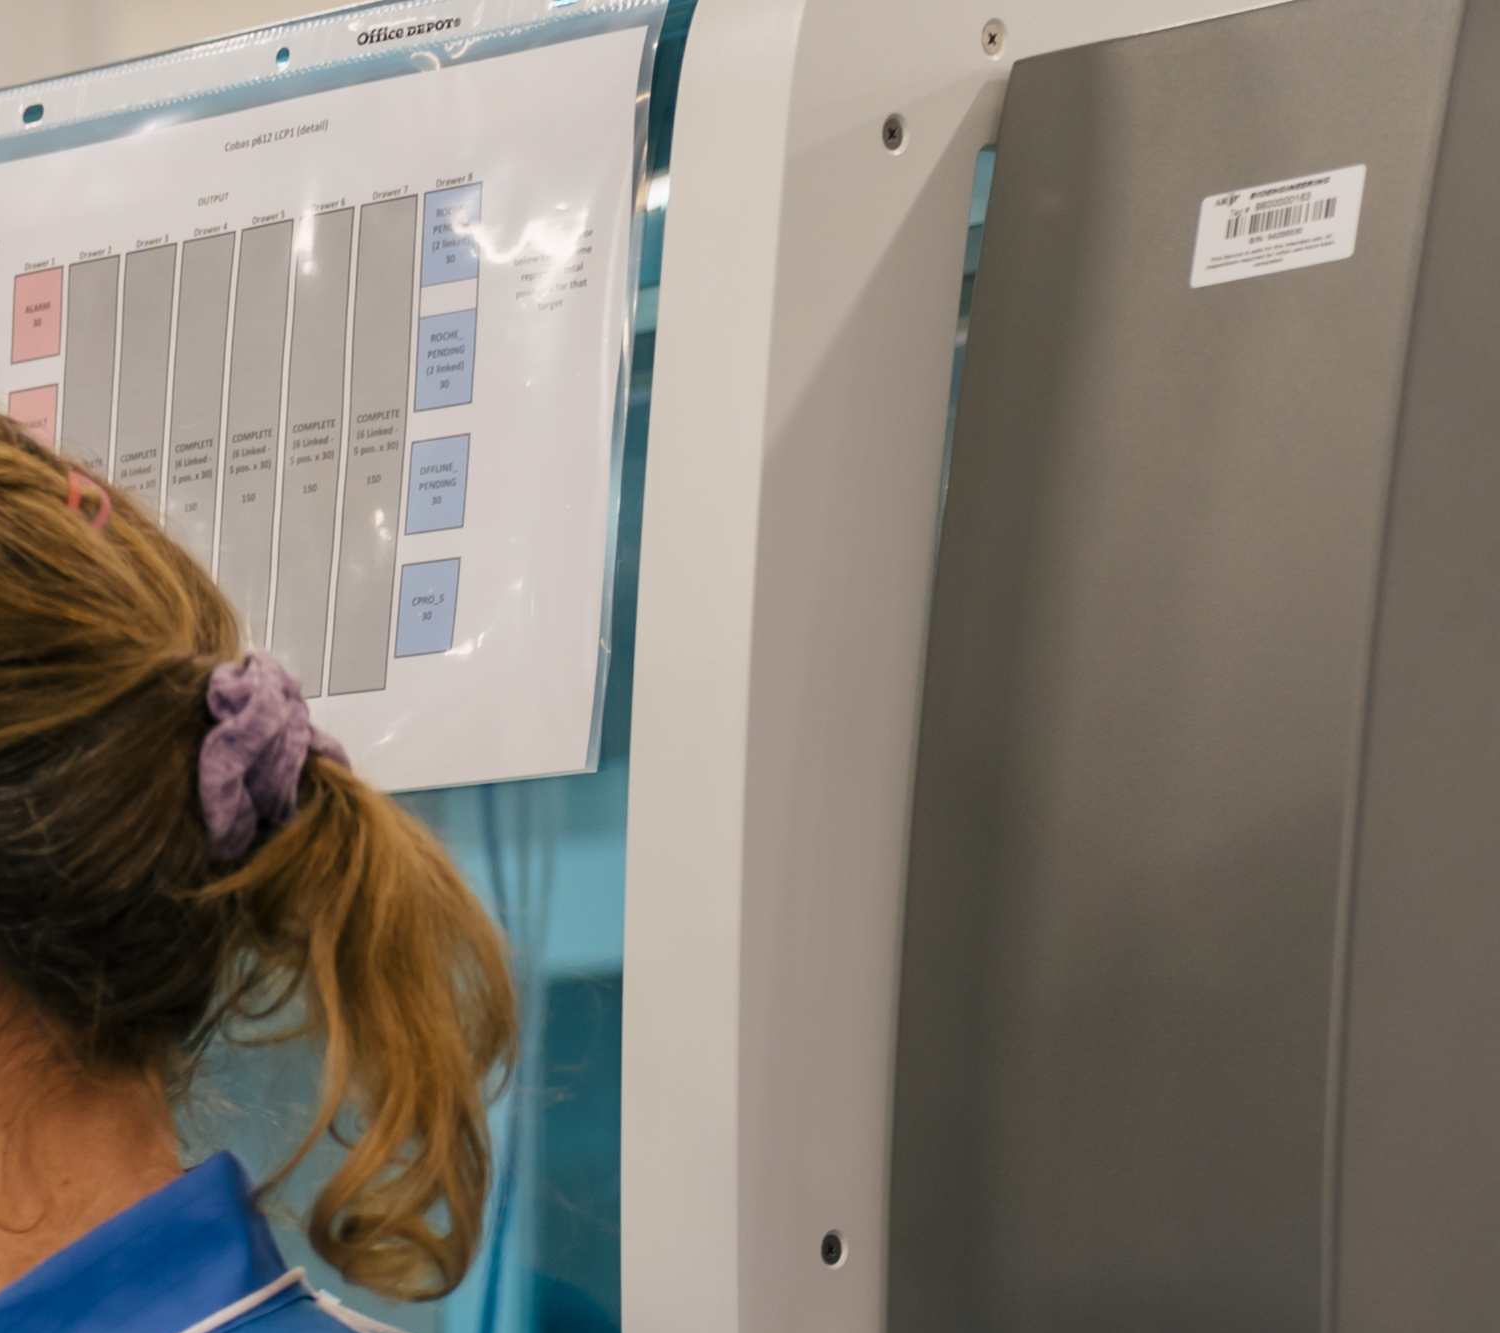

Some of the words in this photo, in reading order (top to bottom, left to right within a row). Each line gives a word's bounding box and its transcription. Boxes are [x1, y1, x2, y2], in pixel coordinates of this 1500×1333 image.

[357, 27, 404, 46] Office
[224, 137, 250, 153] Cobas
[251, 132, 273, 149] p612
[274, 127, 295, 141] LCP1
[296, 119, 329, 138] (detail)
[436, 175, 466, 188] Drawer
[197, 192, 230, 207] OUTPUT
[372, 187, 401, 200] Drawer
[252, 213, 279, 226] Drawer
[194, 225, 221, 237] Drawer
[136, 237, 162, 249] Drawer
[79, 248, 105, 261] Drawer
[445, 254, 456, 265] 30
[24, 260, 49, 271] Drawer
[570, 278, 588, 290] that
[25, 301, 51, 314] ALARM
[537, 299, 564, 311] target
[427, 345, 465, 360] PENDING
[426, 365, 435, 377] (2
[436, 360, 465, 375] linked)
[439, 379, 450, 391] 30
[356, 408, 401, 424] COMPLETE
[292, 418, 336, 434] COMPLETE
[366, 425, 394, 437] Linked
[232, 428, 273, 444] COMPLETE
[302, 435, 330, 448] Linked
[175, 437, 213, 453] COMPLETE
[241, 445, 266, 457] Linked
[120, 448, 157, 464] COMPLETE
[184, 455, 208, 467] Linked
[366, 474, 382, 485] 150
[418, 477, 457, 492] PENDING
[303, 483, 318, 494] 150
[241, 493, 256, 504] 150
[431, 495, 442, 506] 30
[184, 502, 198, 513] 150
[421, 611, 432, 621] 30
